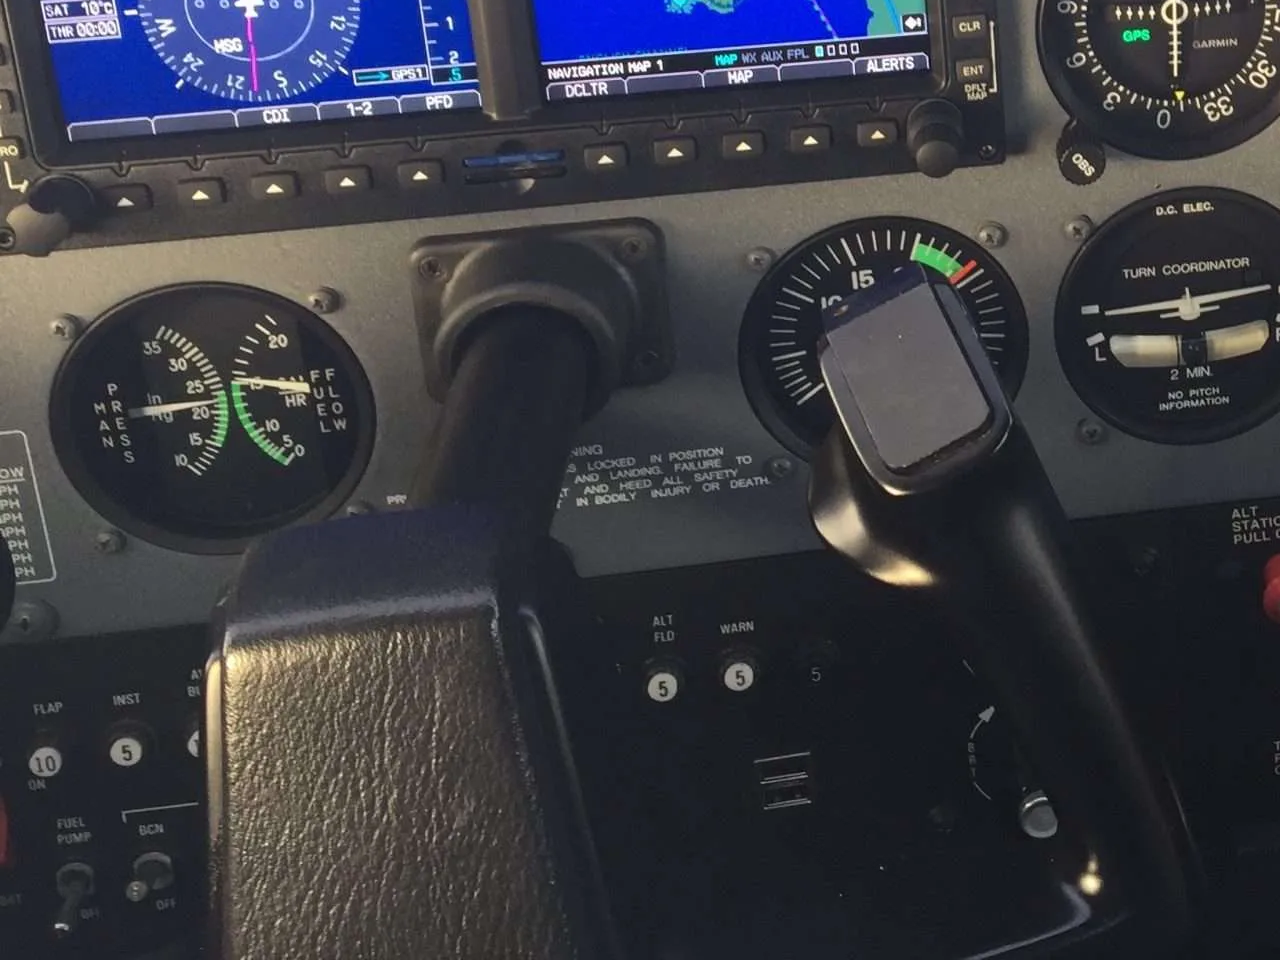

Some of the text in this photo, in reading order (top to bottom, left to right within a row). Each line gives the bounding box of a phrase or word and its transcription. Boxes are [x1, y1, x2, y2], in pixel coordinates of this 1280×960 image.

[959, 20, 980, 33] CLR
[1122, 29, 1151, 42] GPS
[1192, 38, 1238, 49] GARMIN
[715, 47, 809, 66] MAP WX AUX FPL
[867, 55, 914, 72] ALERTS
[548, 60, 652, 78] NAVIGATION MAP
[962, 63, 984, 76] ENT
[565, 82, 608, 97] DCLTR
[426, 95, 453, 109] PFD
[263, 110, 290, 124] CDI
[1072, 152, 1096, 178] OBS
[1155, 201, 1215, 217] D.C. ELEC.
[1122, 257, 1251, 281] TURN COORDINATOR
[851, 270, 876, 288] 15
[268, 333, 288, 350] 20
[168, 357, 188, 373] 30
[1170, 366, 1214, 381] 2 MIN.
[186, 379, 205, 395] 25
[1168, 387, 1220, 400] NO PITCH
[1159, 395, 1230, 412] INFORMATION
[587, 446, 724, 472] LOCKED IN POSITION
[574, 472, 601, 484] AND
[674, 458, 725, 473] FAILURE
[736, 455, 752, 466] TO
[583, 468, 739, 496] AND HEED ALL SAFETY
[576, 476, 771, 506] IN BODILY INJURY OR DEATH.
[1231, 506, 1258, 520] ALT
[1233, 530, 1270, 545] PULL
[653, 615, 673, 627] ALT
[720, 621, 755, 635] WARN
[654, 631, 675, 642] FLD
[112, 693, 141, 706] INST
[33, 702, 63, 715] FLAP
[57, 818, 85, 829] FUEL
[57, 832, 92, 844] PUMP
